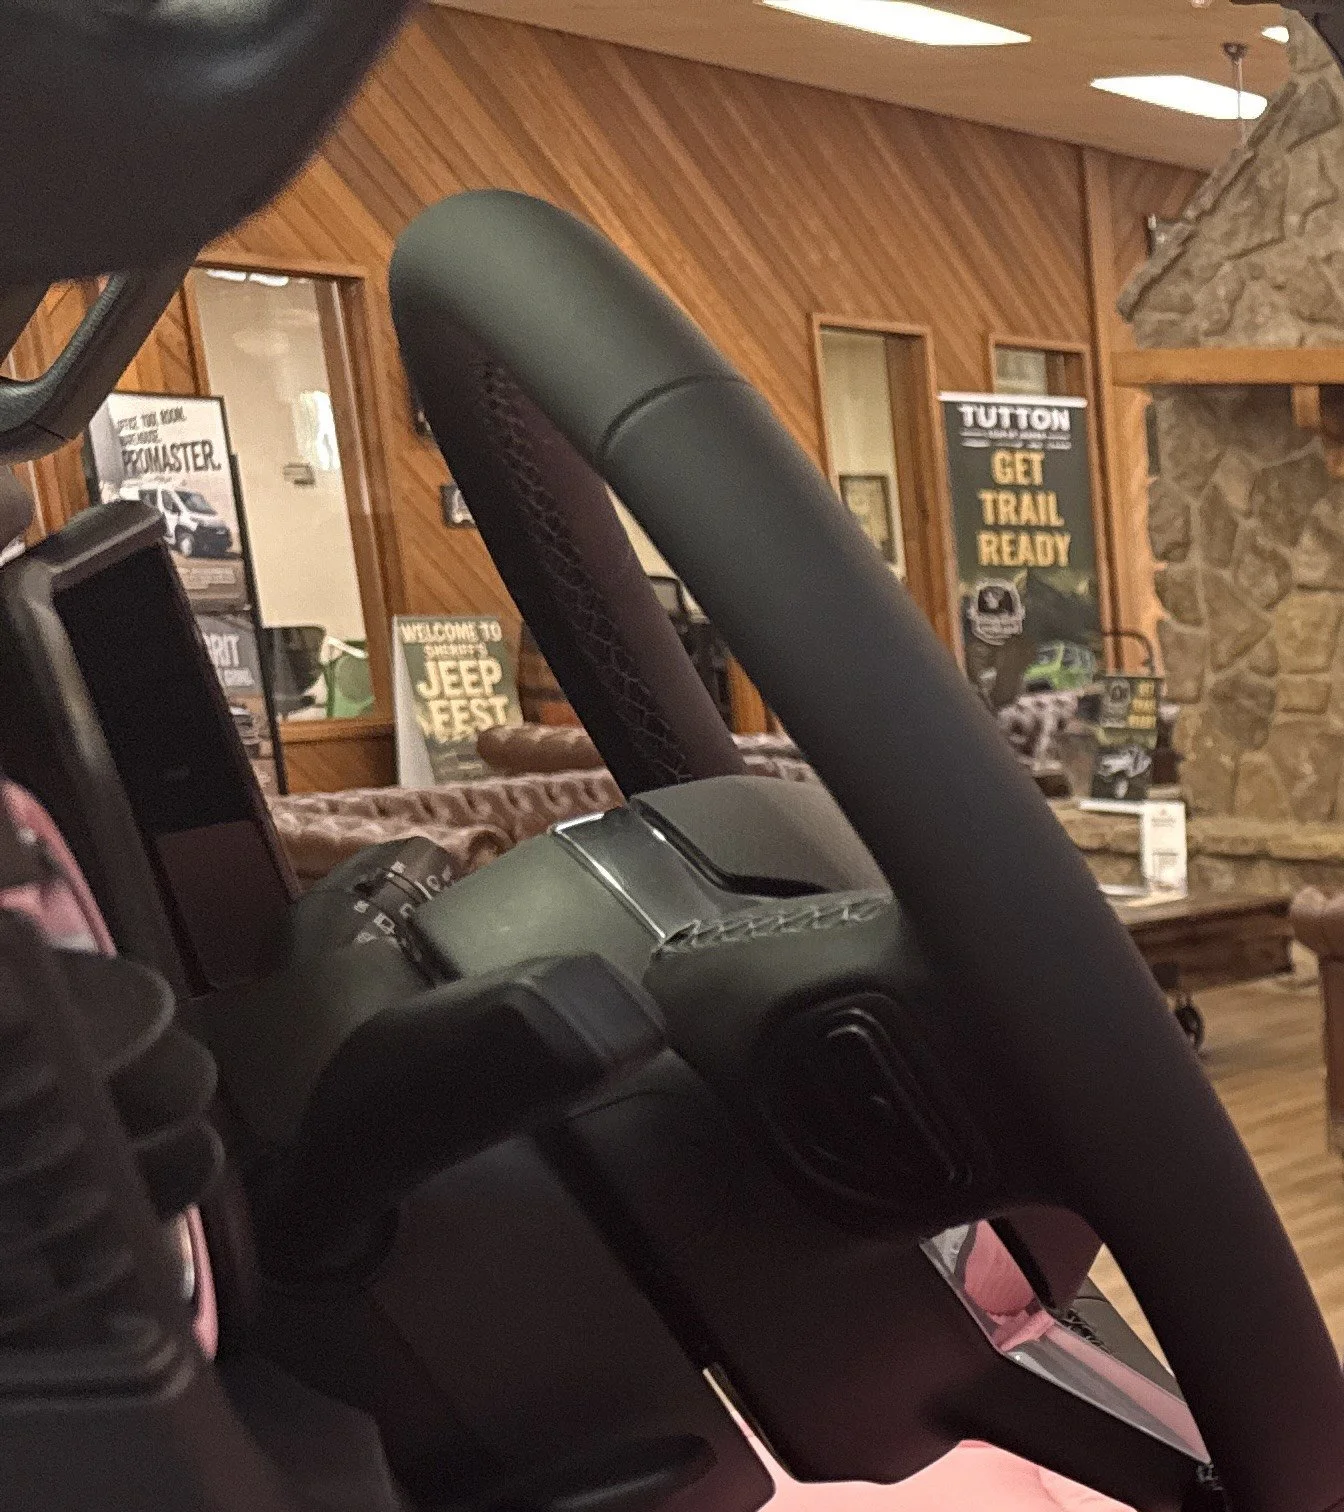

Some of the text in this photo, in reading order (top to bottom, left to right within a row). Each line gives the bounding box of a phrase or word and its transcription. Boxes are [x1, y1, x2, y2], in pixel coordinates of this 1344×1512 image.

[957, 403, 1071, 431] TUTTON
[121, 439, 222, 477] PROMASTER.
[991, 449, 1045, 486] GET
[977, 489, 1065, 527] TRAIL
[977, 530, 1071, 567] READY
[401, 620, 502, 643] WELCOME TO
[416, 657, 502, 699] JEEP
[428, 695, 510, 742] FEST
